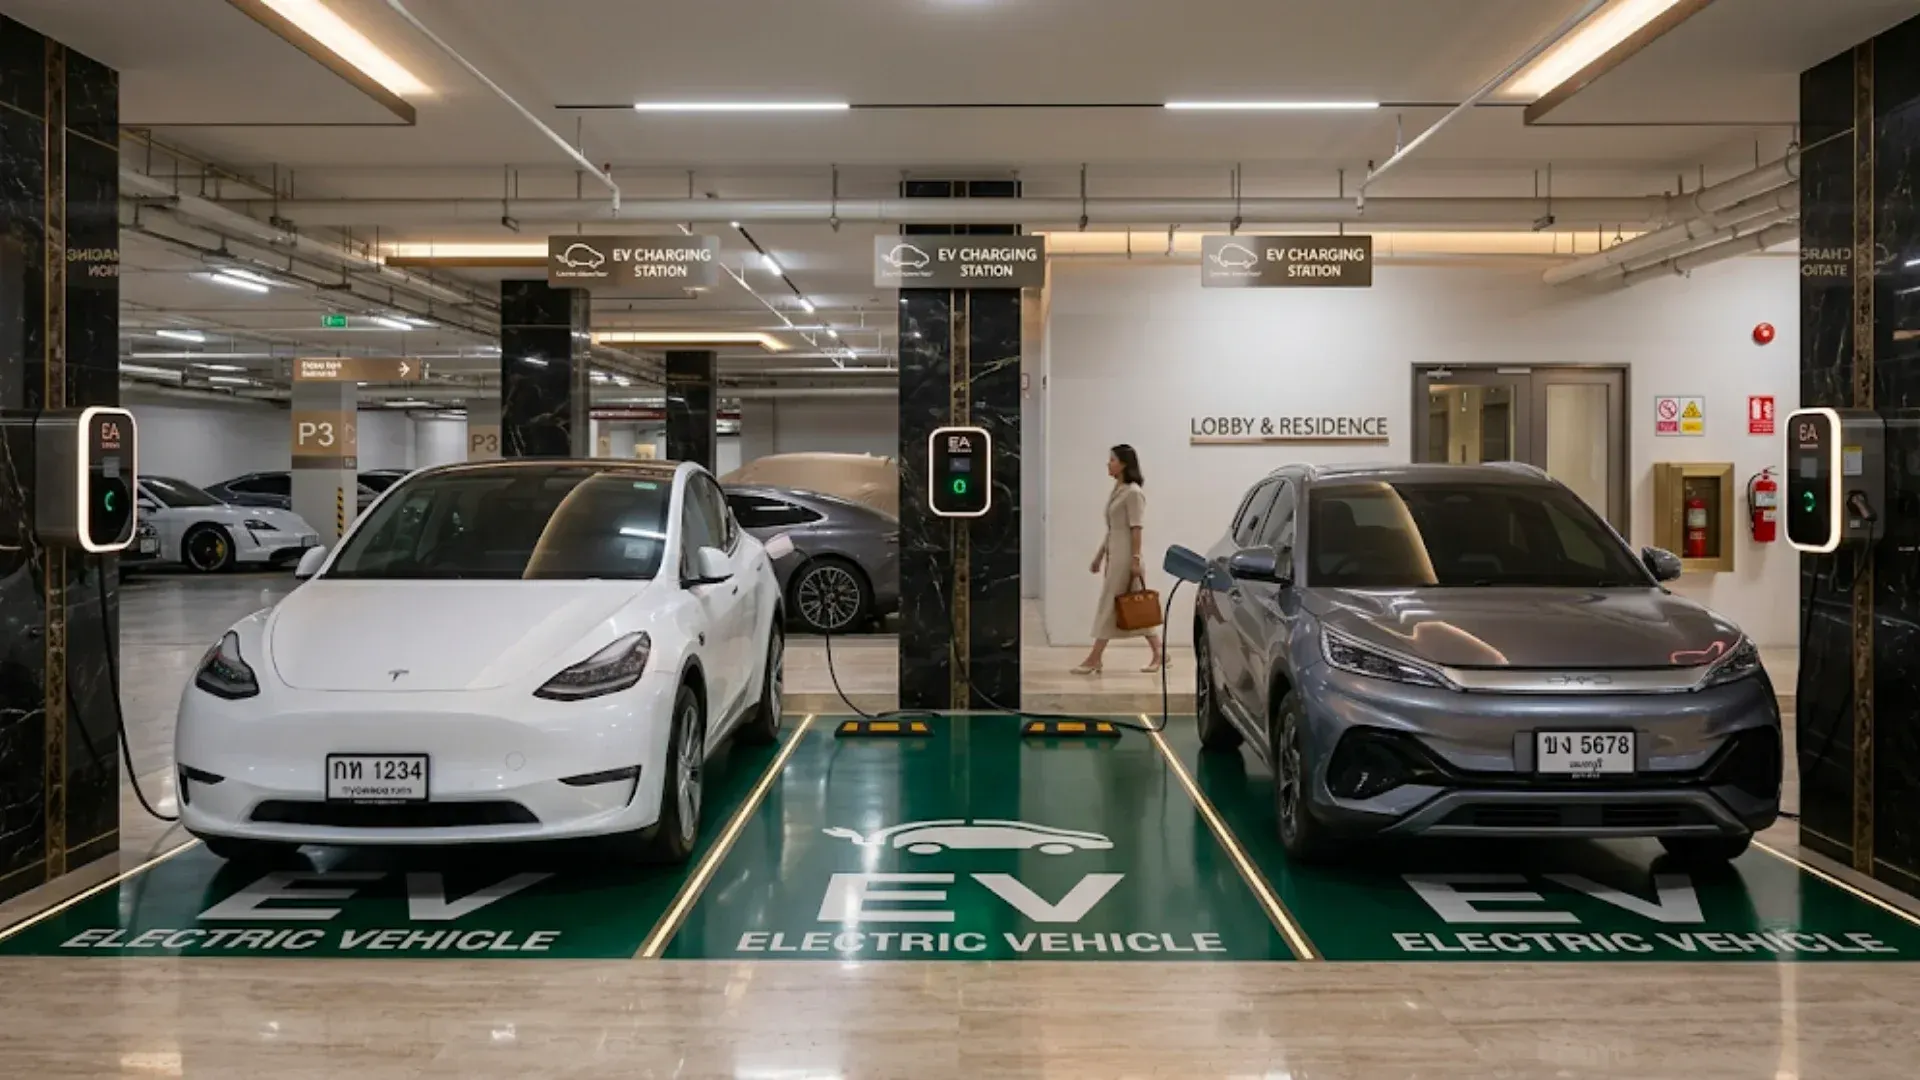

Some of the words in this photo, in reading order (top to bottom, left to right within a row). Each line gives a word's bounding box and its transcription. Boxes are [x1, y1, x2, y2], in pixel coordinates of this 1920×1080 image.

[612, 248, 632, 261] EV
[634, 248, 712, 262] CHARGING
[937, 248, 957, 261] EV
[959, 248, 1037, 262] CHARGING
[1266, 248, 1285, 261] EV
[1287, 248, 1364, 262] CHARGING
[634, 265, 688, 277] STATION
[959, 265, 1013, 277] STATION
[1287, 265, 1342, 277] STATION
[101, 422, 120, 440] EA
[299, 422, 335, 446] P3
[1190, 417, 1255, 435] LOBBY
[1260, 417, 1274, 435] &
[1280, 417, 1388, 435] RESIDENCE
[471, 434, 498, 452] P3
[947, 436, 971, 448] EA
[1544, 736, 1572, 754] ขง
[1581, 736, 1630, 754] 5678
[333, 760, 362, 779] กท
[374, 760, 422, 779] 1234
[197, 872, 557, 920] EV
[816, 873, 1126, 922] EV
[1400, 873, 1706, 923] EV
[59, 928, 327, 949] ELECTRIC
[339, 929, 562, 950] VEHICLE
[735, 932, 988, 952] ELECTRIC
[1002, 932, 1228, 952] VEHICLE
[1391, 932, 1654, 952] ELECTRIC
[1654, 932, 1900, 953] VEHICLE
